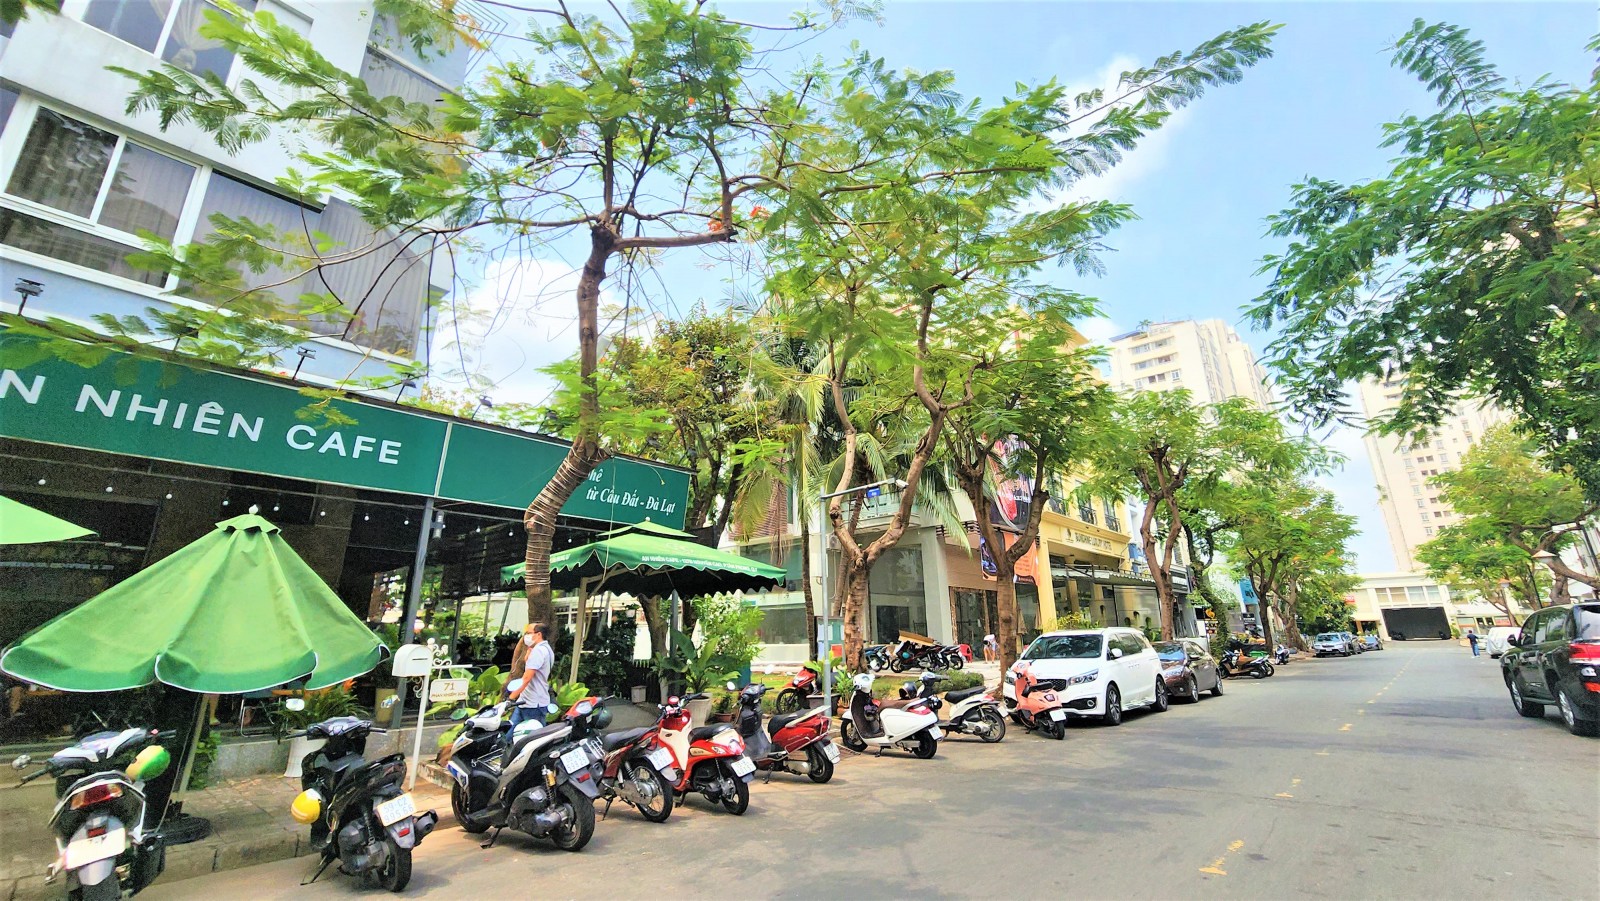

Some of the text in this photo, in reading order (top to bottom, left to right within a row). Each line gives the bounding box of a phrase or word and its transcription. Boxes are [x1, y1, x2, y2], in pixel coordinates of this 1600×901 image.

[0, 369, 402, 464] N NHIÊN CAFE
[587, 468, 604, 482] hê
[586, 486, 599, 500] từ
[621, 489, 640, 507] Đất
[646, 496, 660, 511] Đà
[660, 499, 676, 516] Lạt
[444, 682, 454, 691] 71
